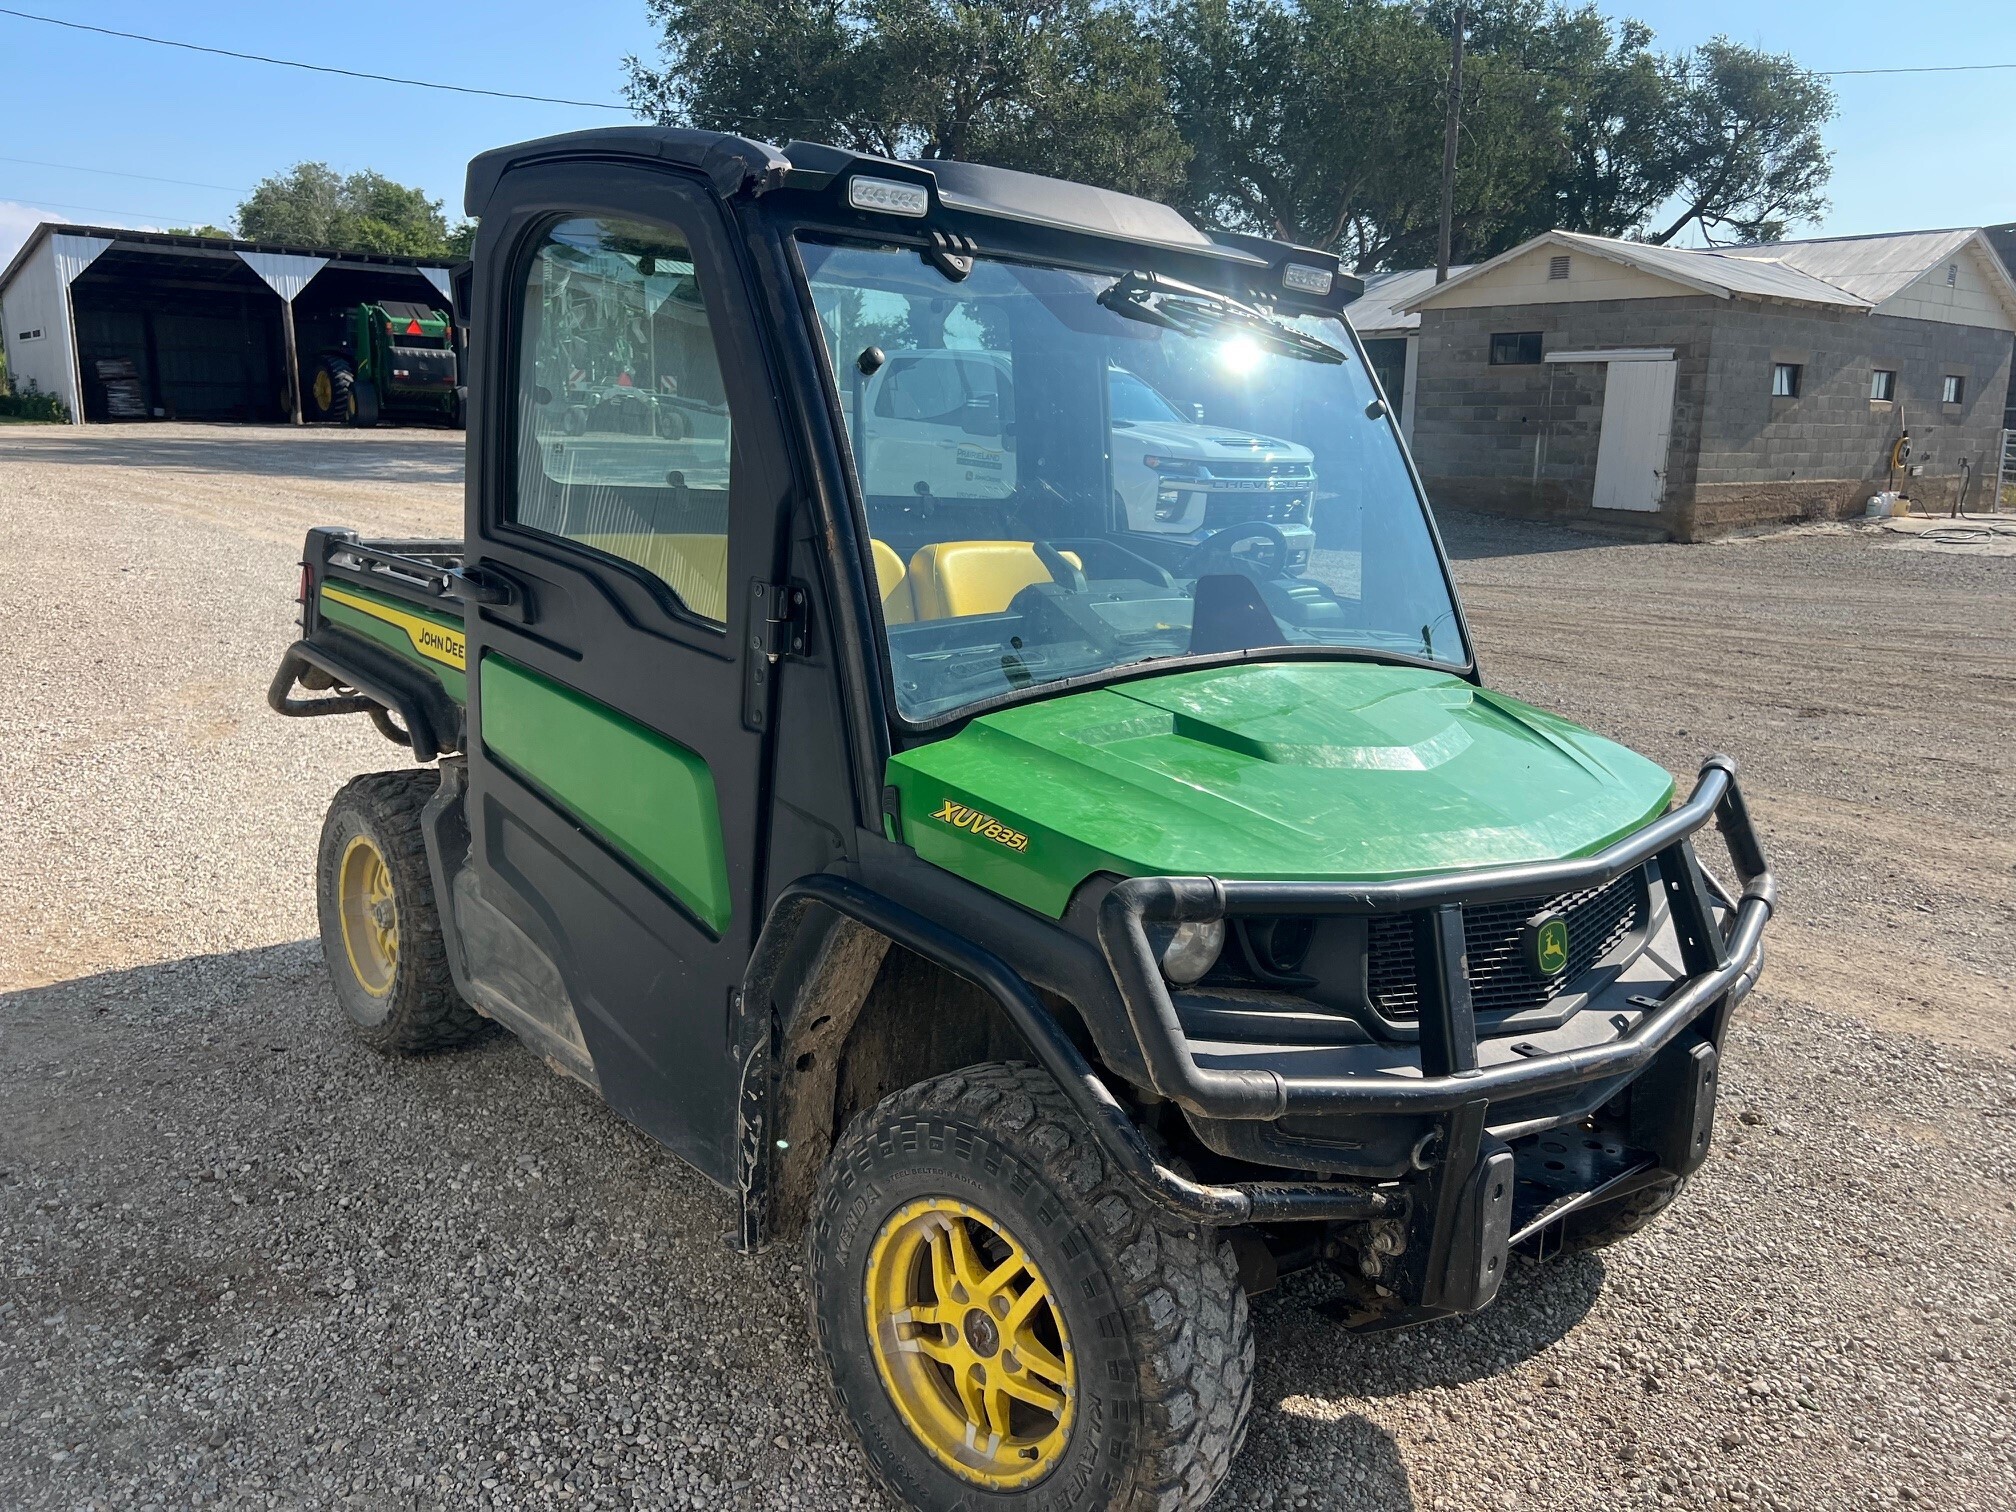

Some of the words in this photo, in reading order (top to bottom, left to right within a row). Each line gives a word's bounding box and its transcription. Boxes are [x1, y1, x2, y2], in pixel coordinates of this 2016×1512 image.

[419, 627, 444, 651] JOHN
[885, 1170, 910, 1183] STEEL
[911, 1167, 944, 1175] BELTED
[945, 1171, 984, 1191] RADIAL
[834, 1182, 883, 1268] KENDA
